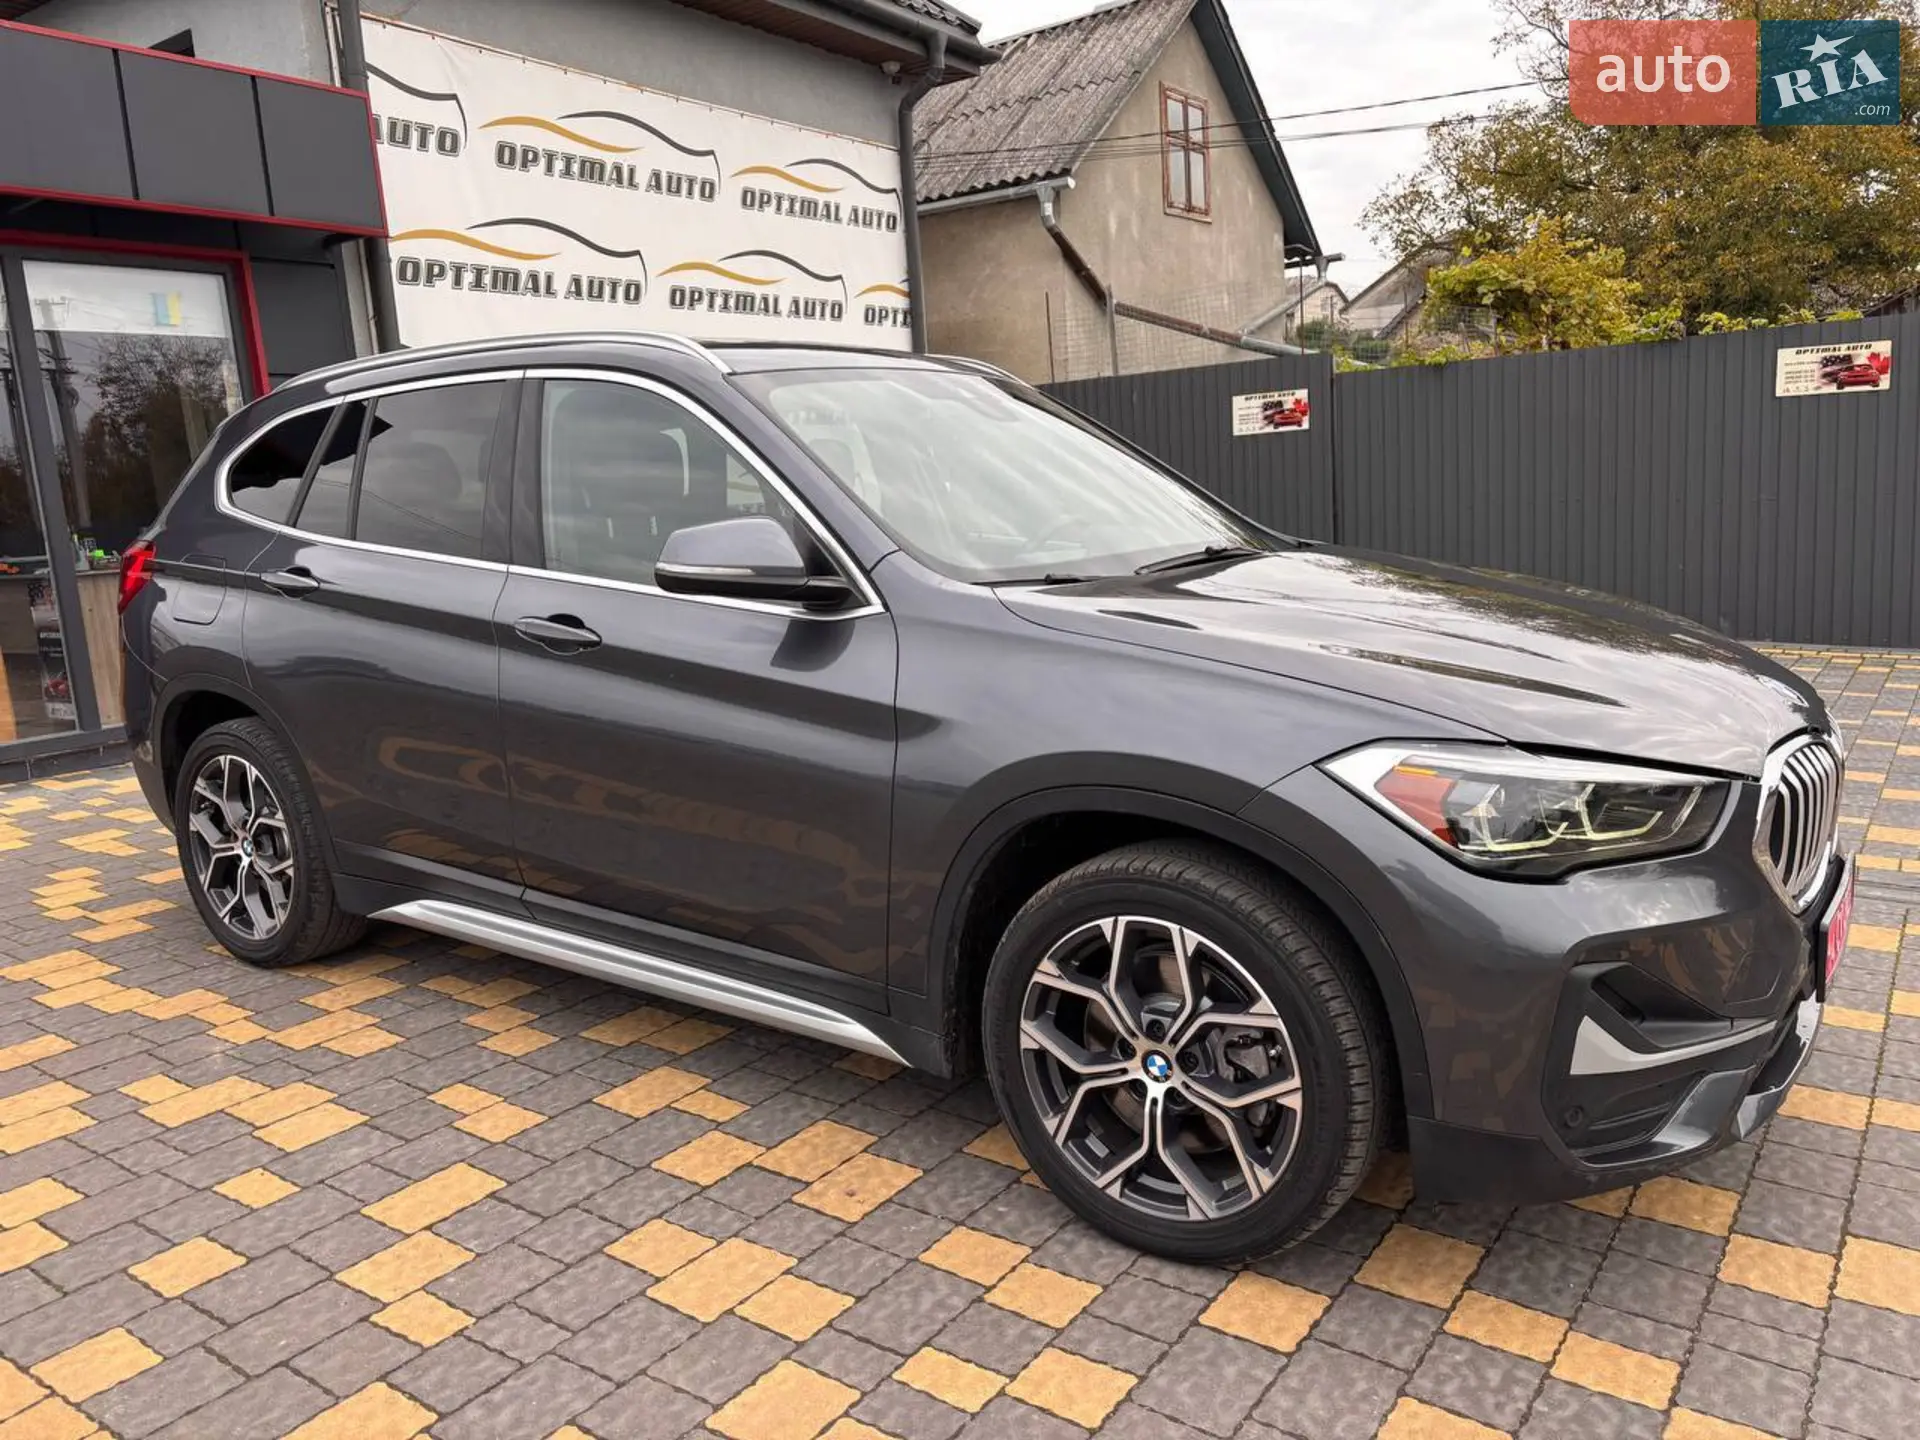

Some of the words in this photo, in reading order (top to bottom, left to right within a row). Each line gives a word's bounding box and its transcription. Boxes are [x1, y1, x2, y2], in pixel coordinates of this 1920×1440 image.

[494, 140, 640, 190] OPTIMAL
[645, 168, 716, 202] AUTO
[740, 186, 843, 225] OPTIMAL
[847, 205, 898, 233] AUTO
[396, 256, 558, 298] OPTIMAL
[564, 274, 641, 305] AUTO
[669, 285, 783, 318] OPTIMAL
[787, 297, 844, 322] AUTO
